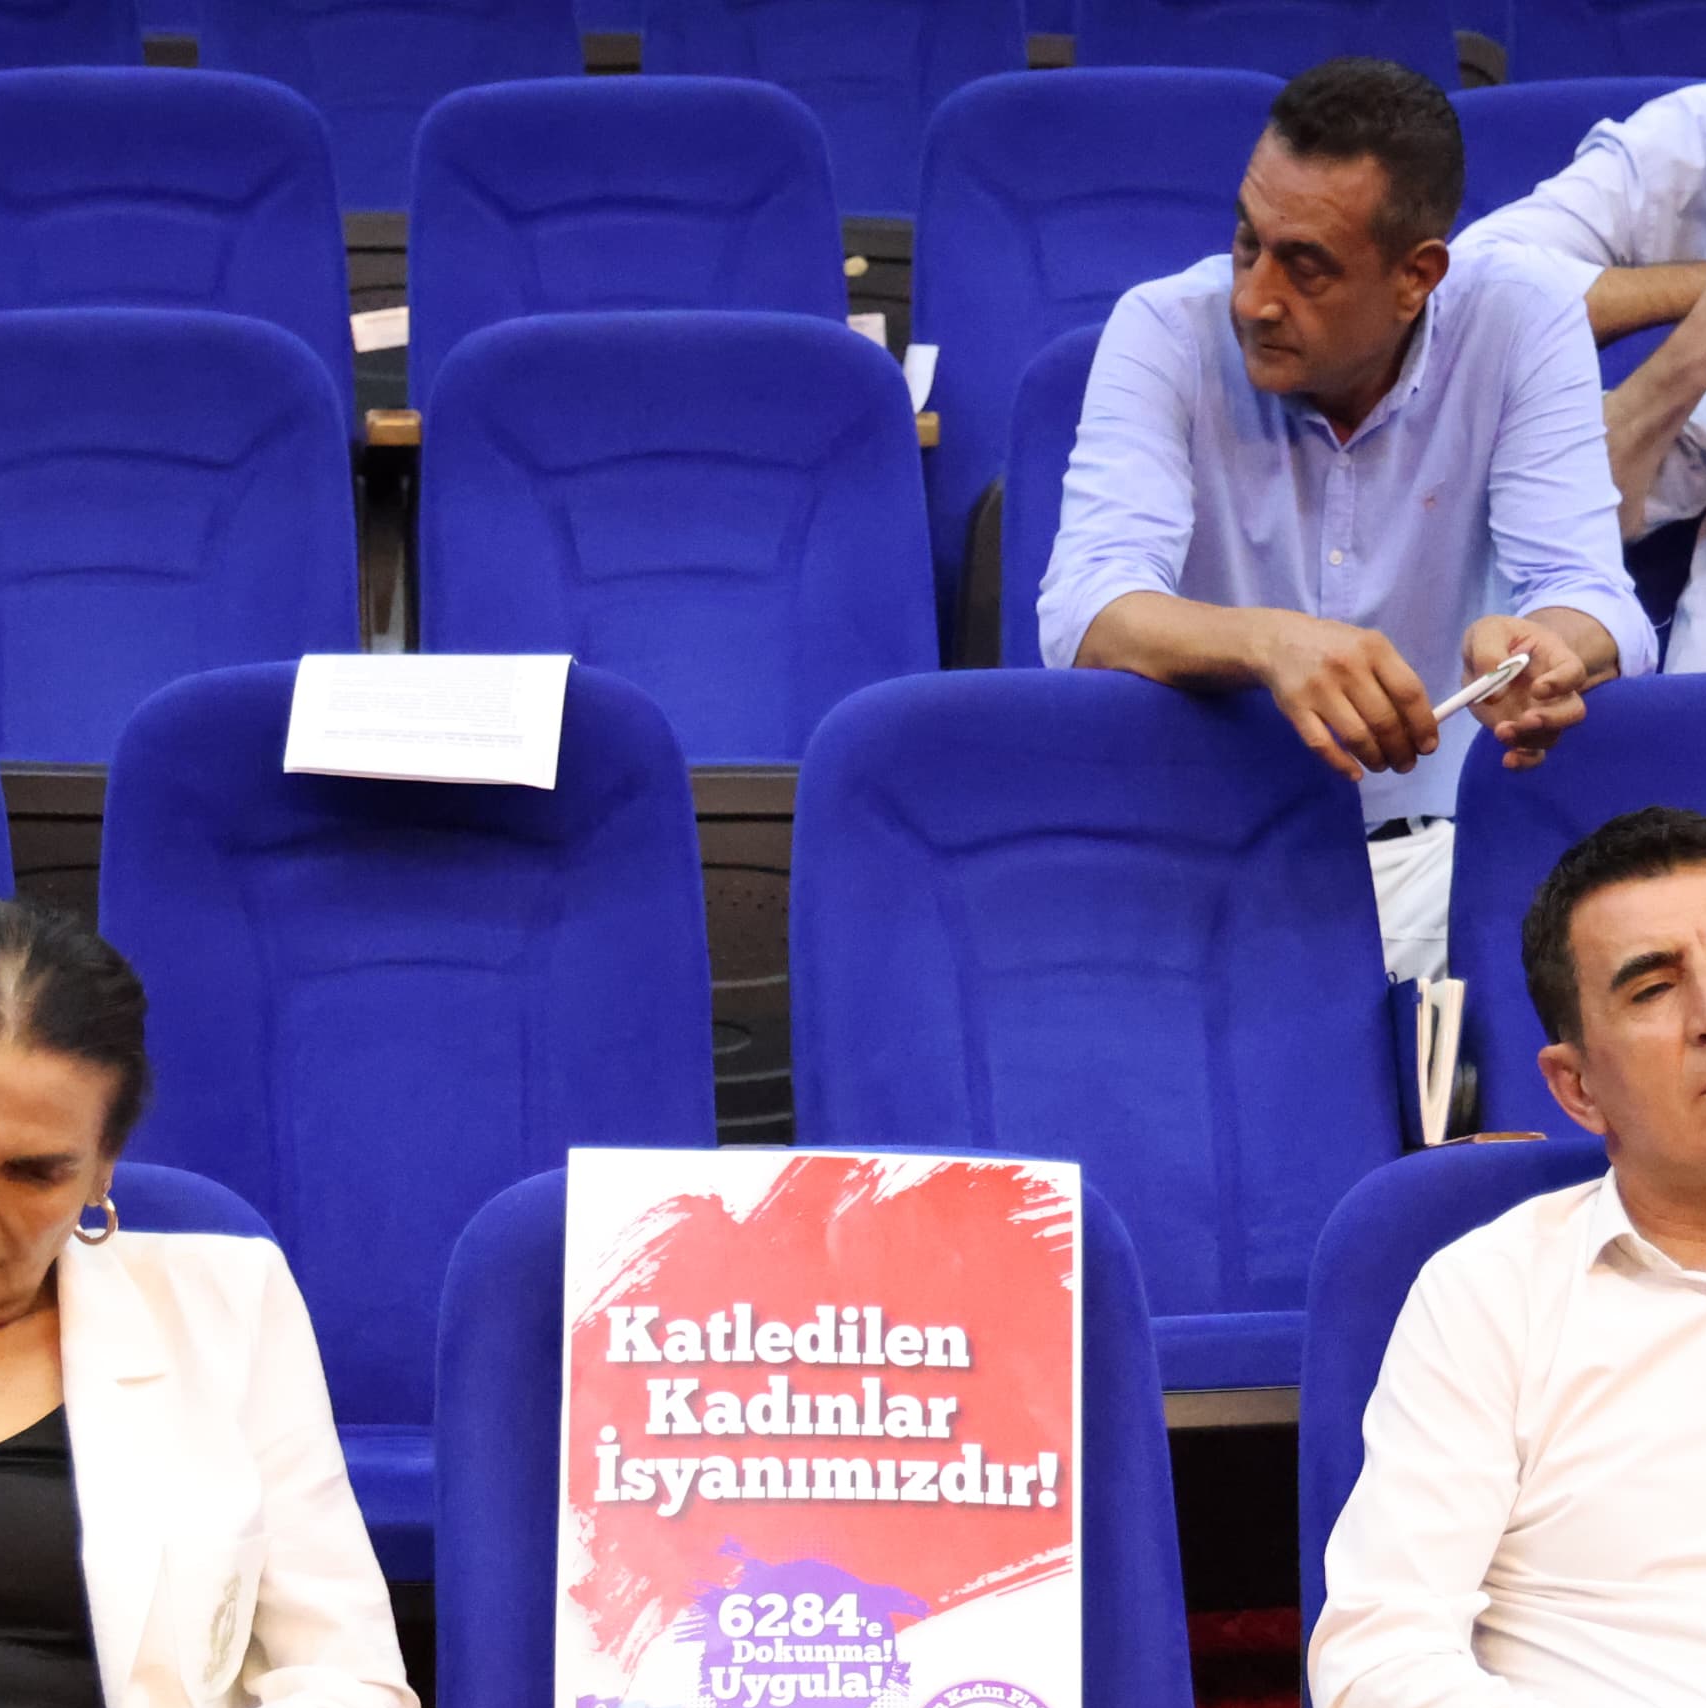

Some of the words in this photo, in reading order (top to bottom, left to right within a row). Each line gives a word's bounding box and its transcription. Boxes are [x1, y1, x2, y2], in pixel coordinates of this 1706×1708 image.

[605, 1303, 970, 1368] Katledilen
[645, 1375, 957, 1438] Kadınlar
[594, 1425, 1058, 1517] İsyanımızdır!
[731, 1637, 894, 1664] Dokunma!
[709, 1662, 884, 1708] Uygula!
[943, 1683, 1006, 1707] Kadın
